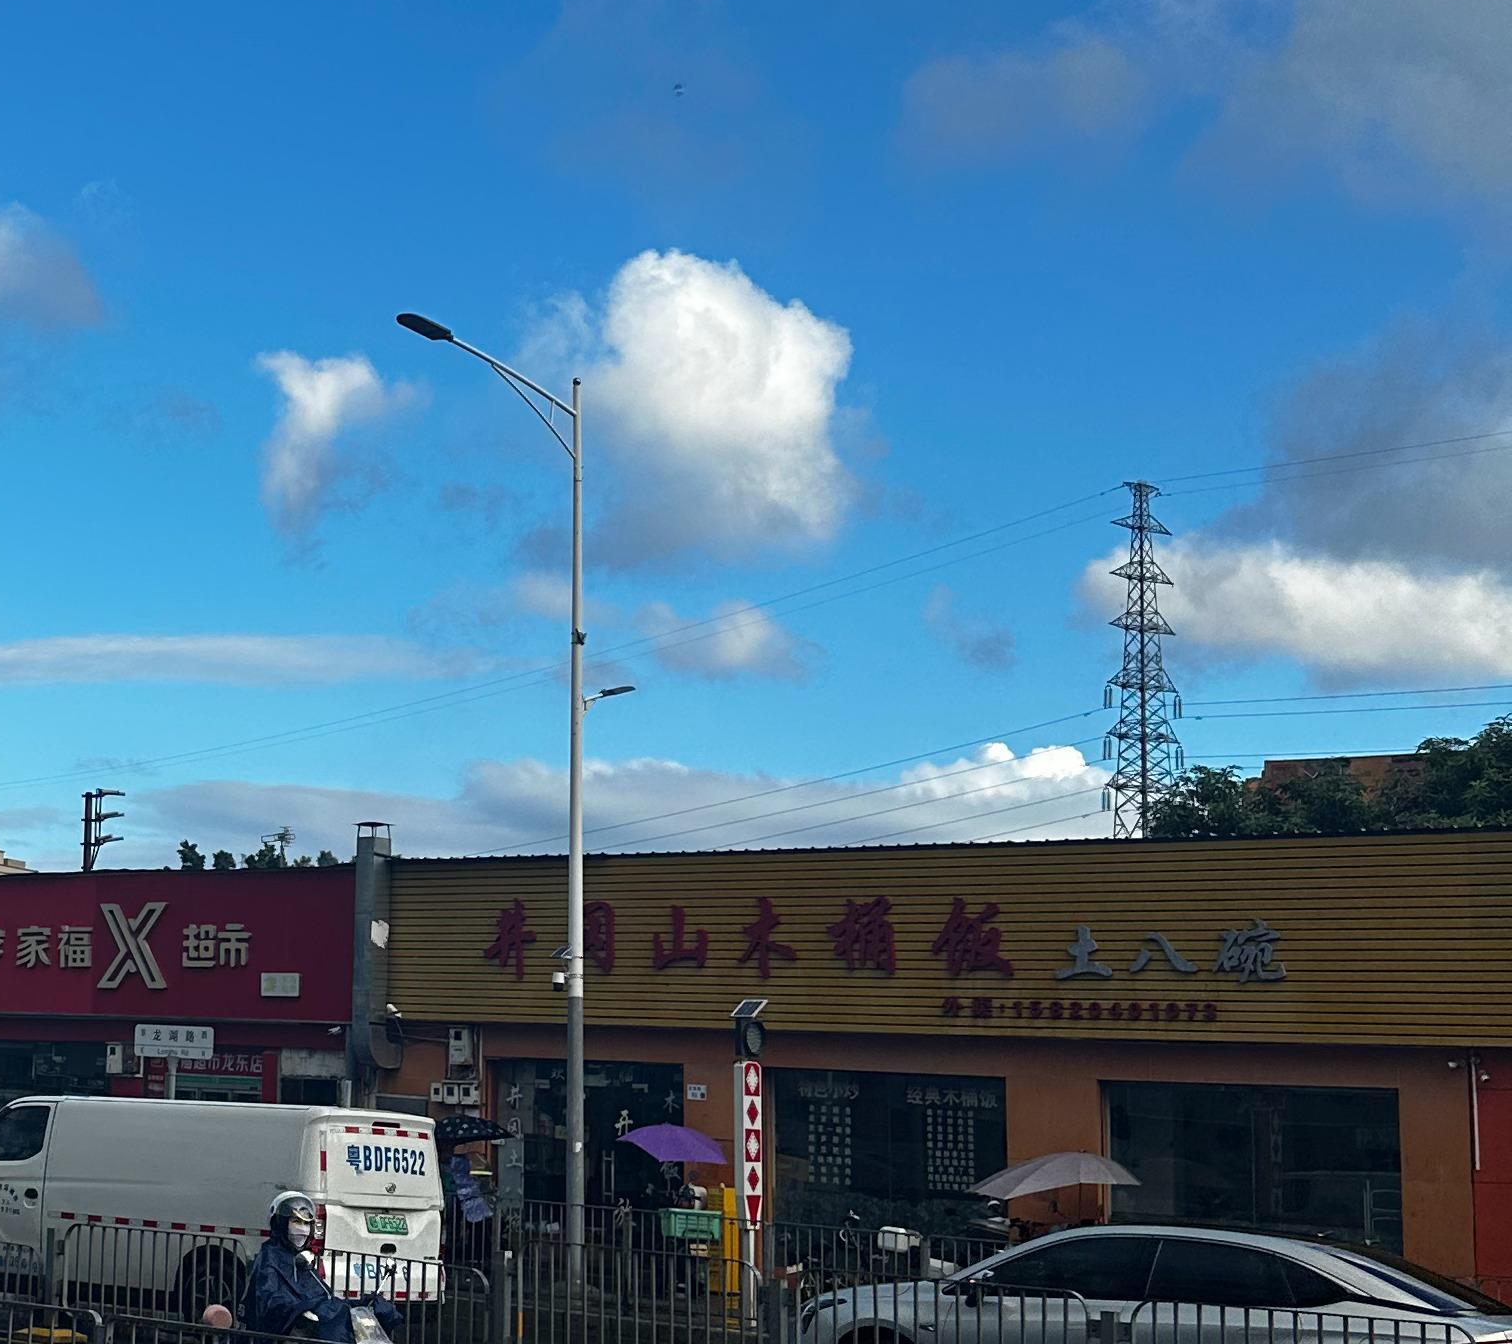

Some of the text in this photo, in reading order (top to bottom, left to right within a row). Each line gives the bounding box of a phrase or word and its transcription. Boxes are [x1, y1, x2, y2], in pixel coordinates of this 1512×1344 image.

[182, 922, 252, 969] 超市
[1056, 918, 1288, 986] 土八碗
[153, 1029, 195, 1044] 龙湖路
[346, 1144, 426, 1177] 粤BDF6522
